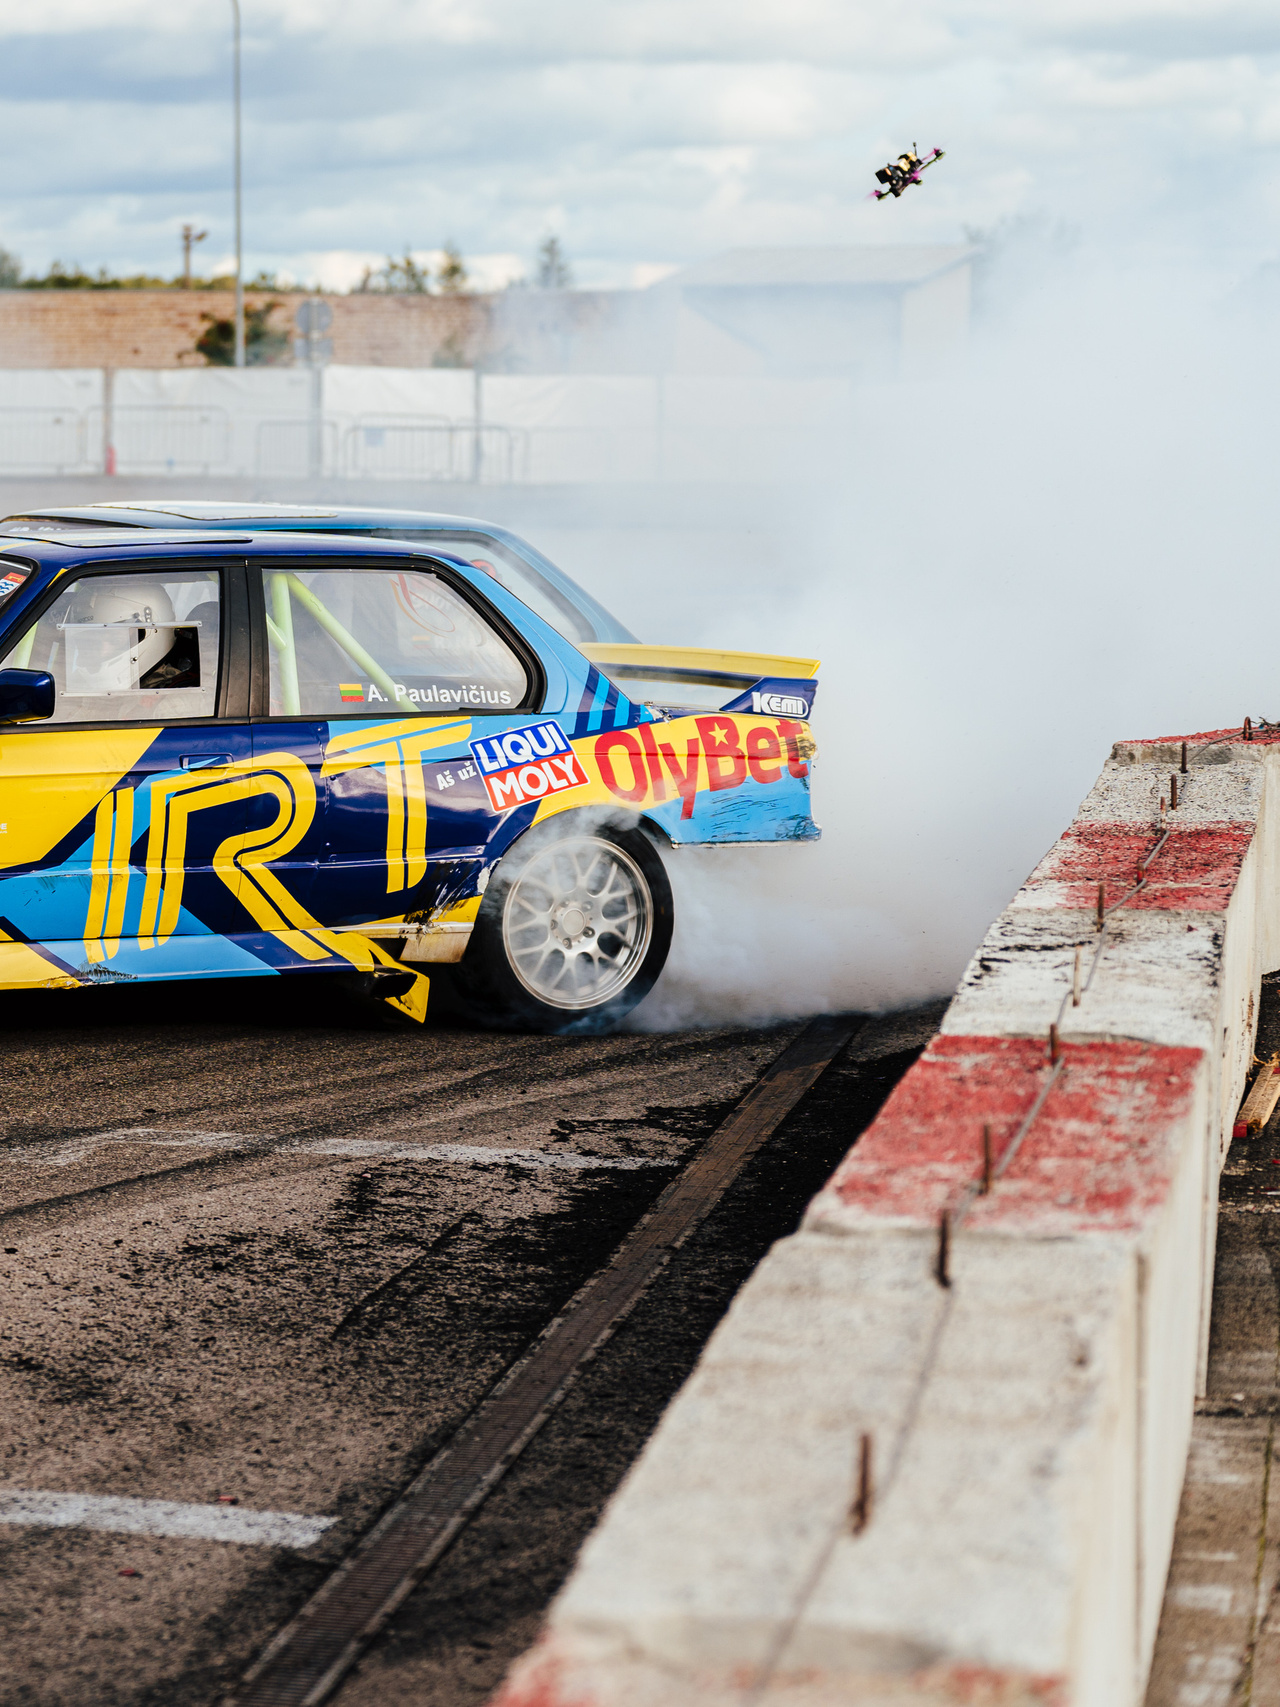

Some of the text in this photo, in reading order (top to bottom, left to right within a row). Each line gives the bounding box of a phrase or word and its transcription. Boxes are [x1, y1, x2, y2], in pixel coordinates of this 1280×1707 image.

[367, 684, 512, 705] A. Paulavičius
[474, 723, 567, 773] LIQUI
[594, 716, 809, 821] OlyBet
[435, 761, 478, 791] Aš už
[488, 754, 580, 808] MOLY
[82, 716, 473, 972] IRT
